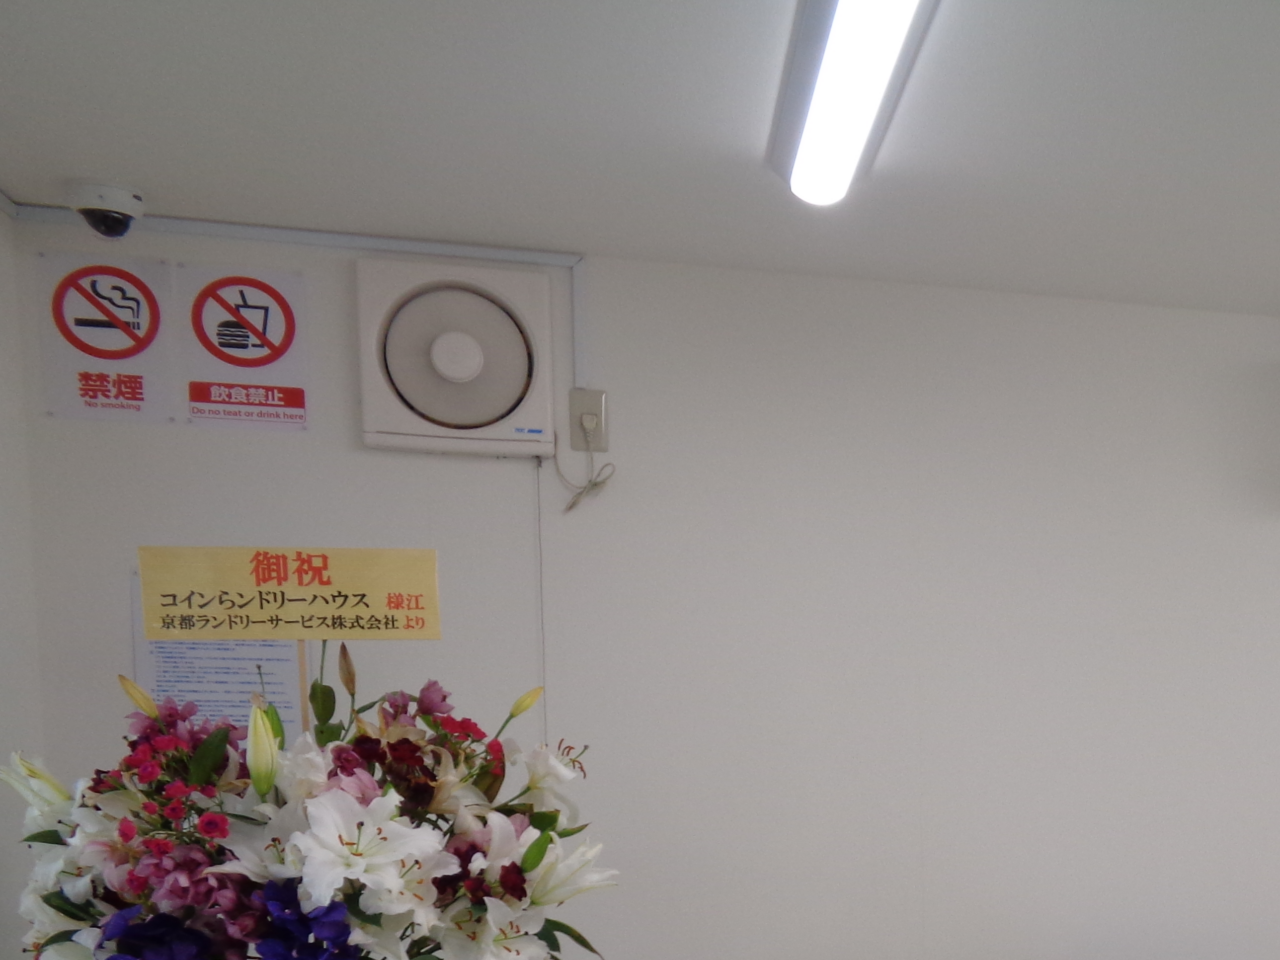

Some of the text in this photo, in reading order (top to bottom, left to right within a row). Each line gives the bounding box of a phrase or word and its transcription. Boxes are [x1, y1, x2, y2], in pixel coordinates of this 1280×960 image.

[77, 371, 145, 401] 禁煙
[210, 385, 285, 405] 飲食禁止
[84, 400, 141, 411] No smoking
[191, 406, 206, 415] Do
[257, 410, 281, 419] drink
[283, 412, 304, 421] here
[250, 551, 332, 587] 御祝
[160, 591, 425, 611] コインらンドリーハウス 様江
[160, 614, 425, 630] 京都ランドリーサービス株式会社 より
